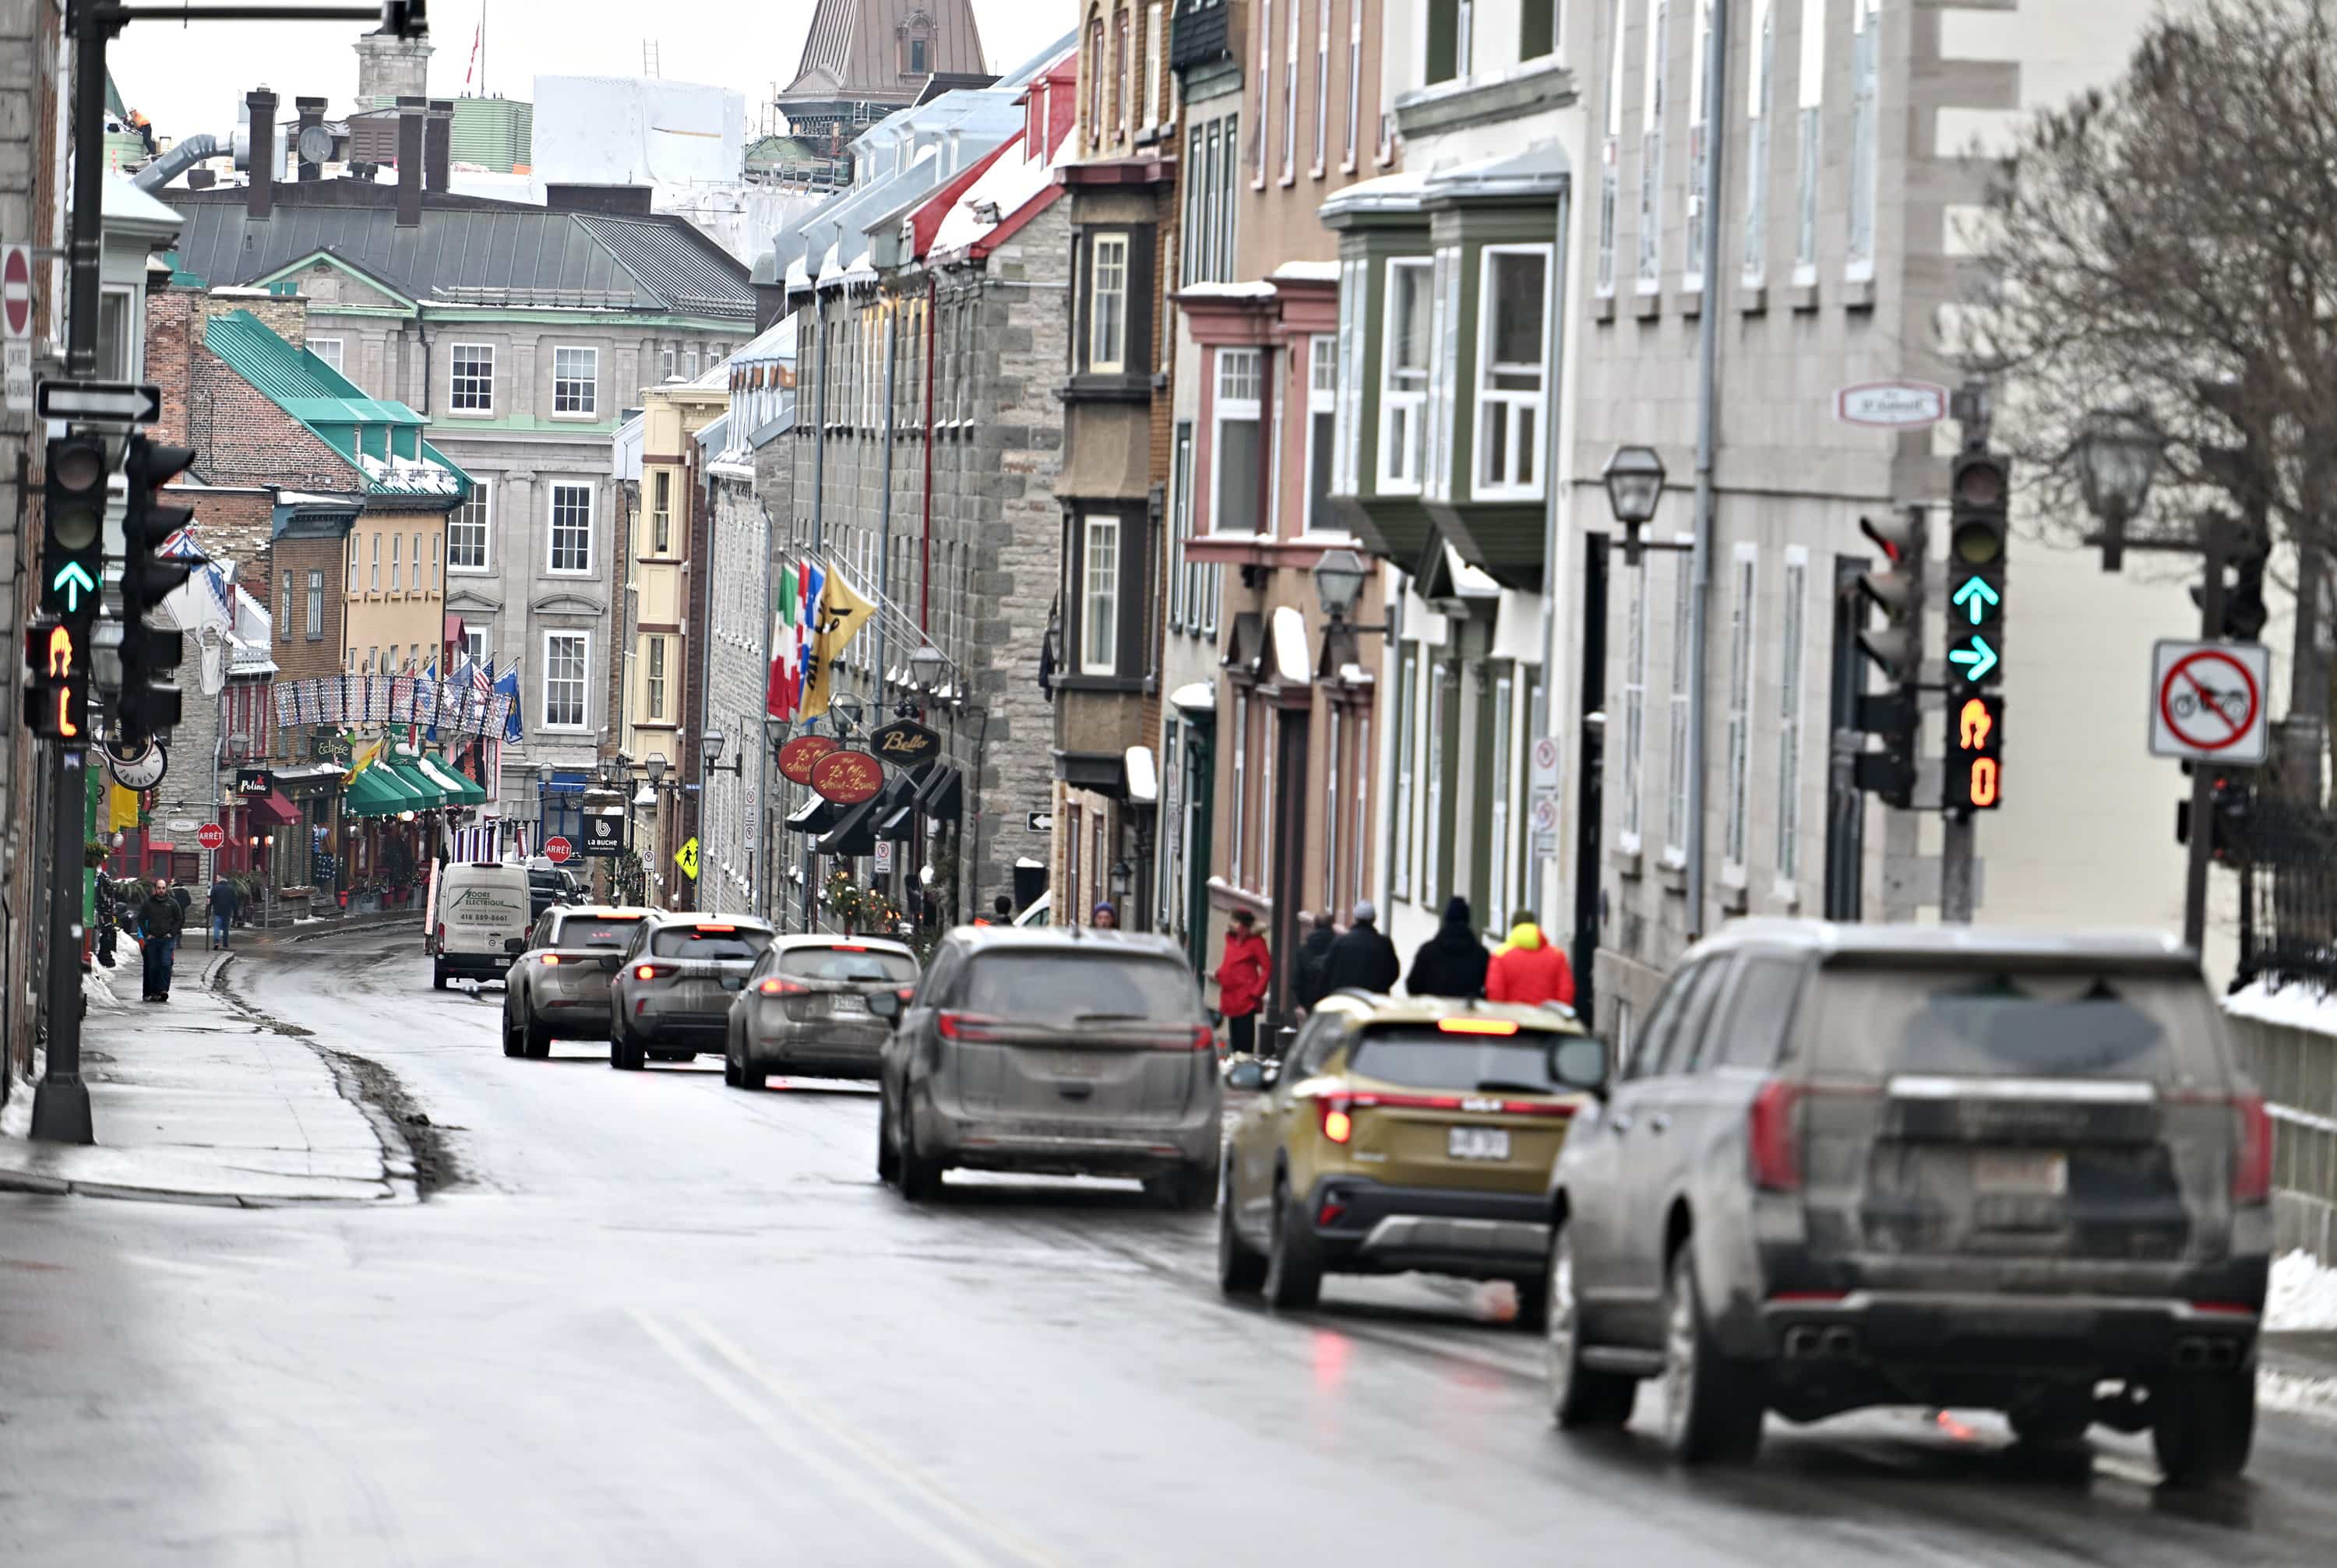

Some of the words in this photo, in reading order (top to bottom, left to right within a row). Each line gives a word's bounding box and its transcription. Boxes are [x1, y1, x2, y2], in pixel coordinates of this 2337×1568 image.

[881, 731, 929, 752] Bello
[118, 769, 155, 785] FRANCE
[241, 780, 266, 793] Polina
[199, 831, 223, 840] ARRÊT
[546, 844, 570, 855] ARRÊT
